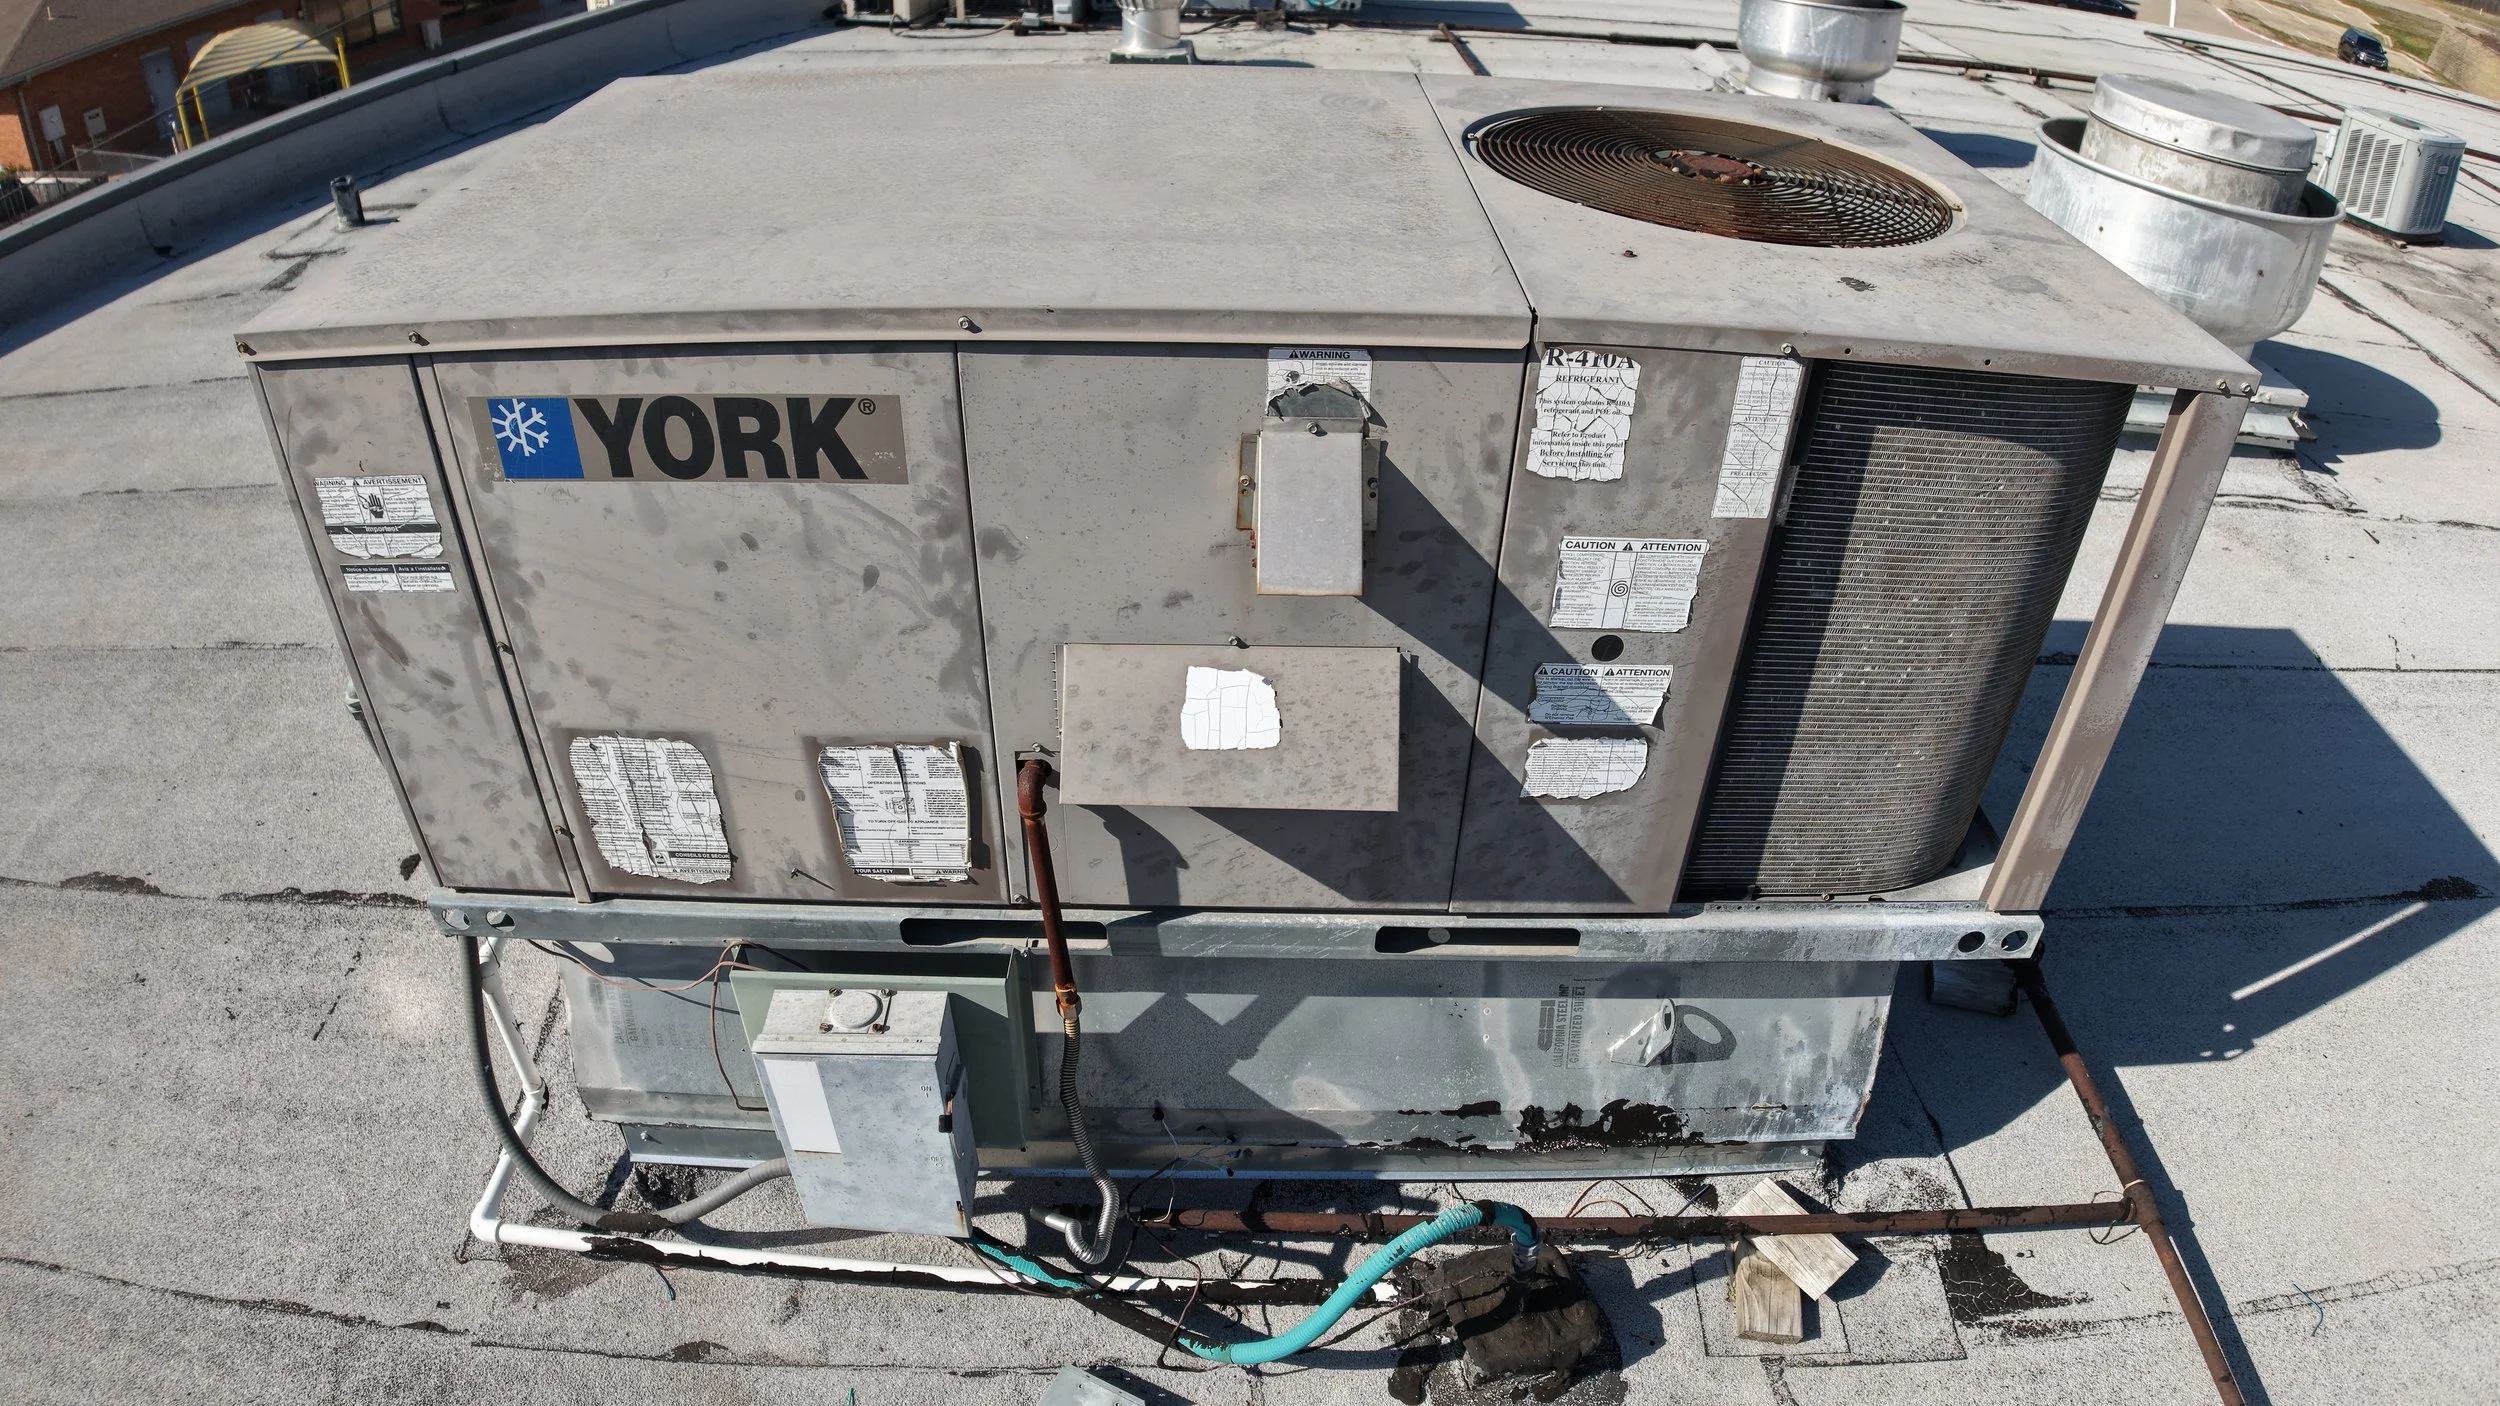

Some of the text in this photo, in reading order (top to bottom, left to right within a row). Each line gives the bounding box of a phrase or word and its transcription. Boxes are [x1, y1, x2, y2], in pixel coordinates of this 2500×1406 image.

[1299, 351, 1350, 359] WARNING
[1546, 347, 1634, 369] R-410A
[1556, 375, 1620, 383] REFRIGERANT
[1540, 449, 1565, 457] Before
[1566, 450, 1603, 458] Installing
[1542, 460, 1578, 468] Servicing
[363, 477, 422, 485] AVERTISSEMENT
[1565, 541, 1616, 549] CAUTION
[1640, 543, 1702, 551] ATTENTION
[1550, 668, 1599, 676] CAUTION
[1616, 669, 1670, 677] ATTENTION
[1556, 999, 1568, 1023] STEEL
[1569, 1015, 1583, 1063] GALVANIZED
[1553, 1024, 1567, 1068] CALIFORNIA
